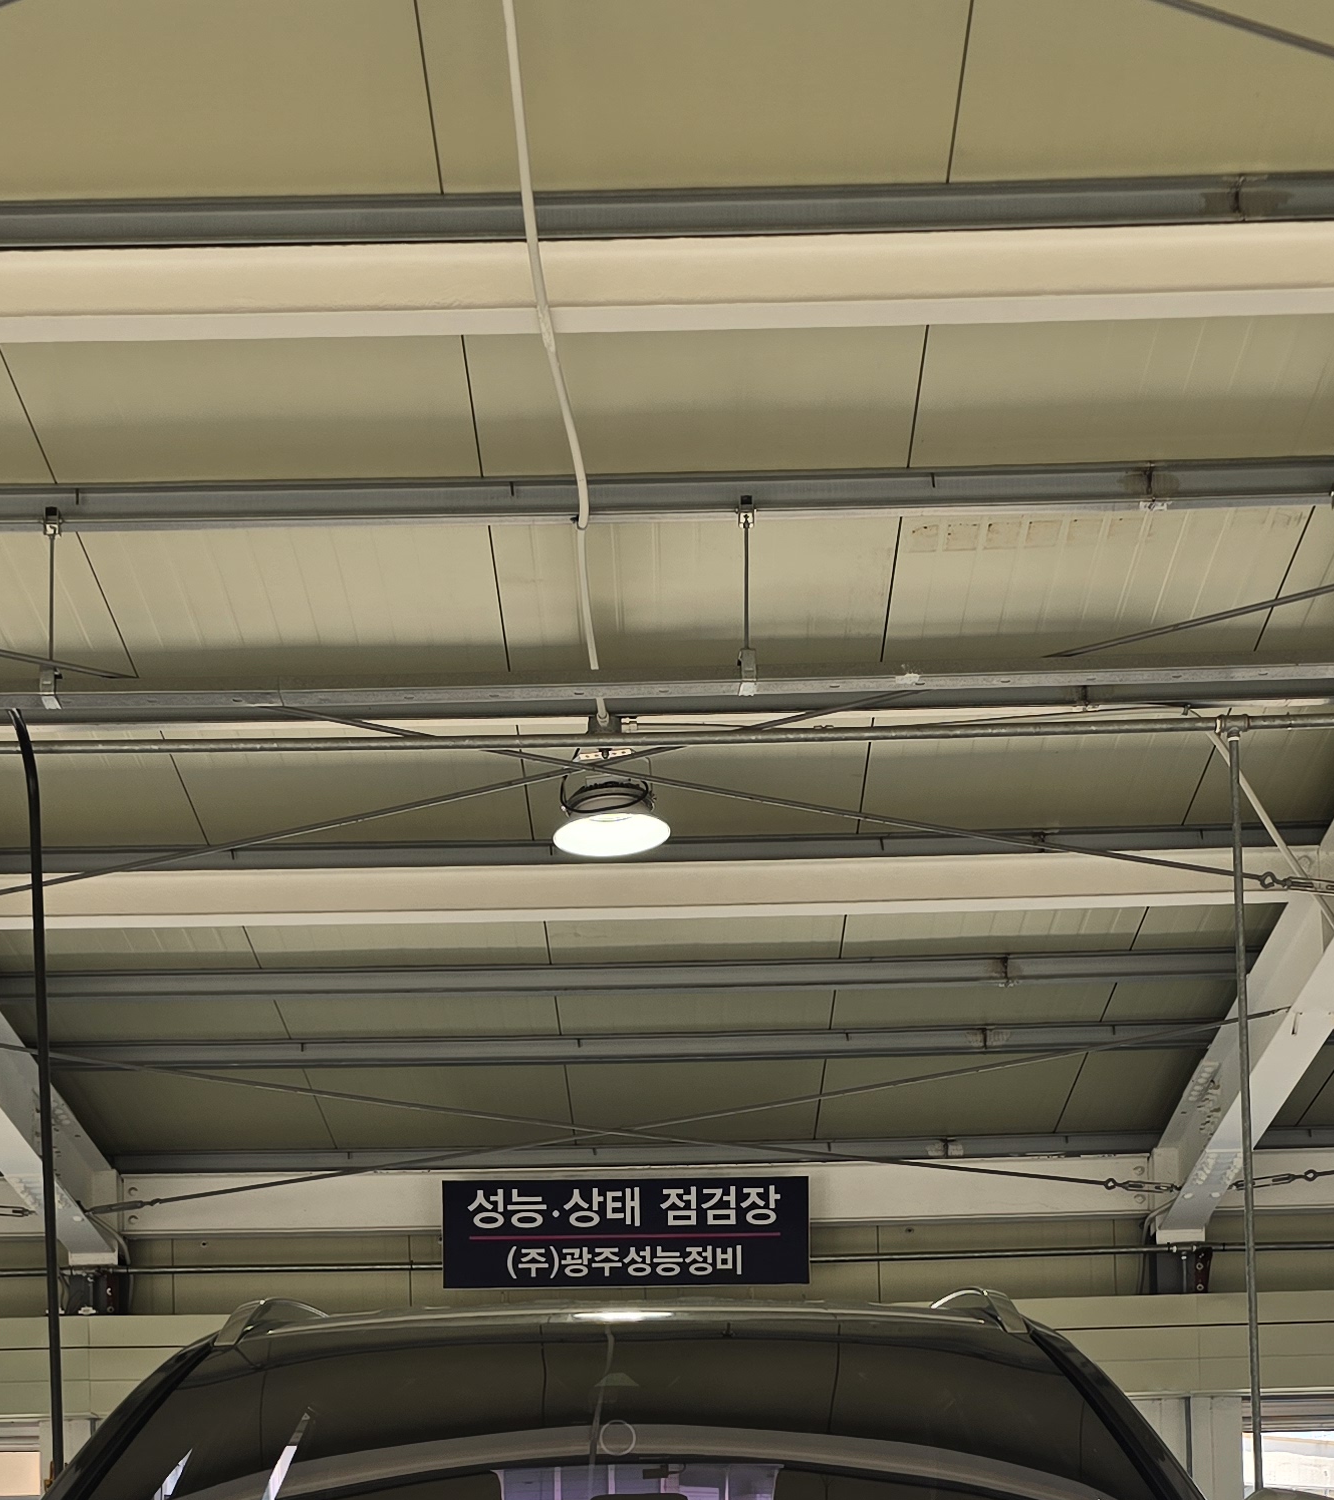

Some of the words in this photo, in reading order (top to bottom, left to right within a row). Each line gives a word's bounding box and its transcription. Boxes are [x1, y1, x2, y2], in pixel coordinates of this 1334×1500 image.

[467, 1187, 641, 1229] 성능·상태
[660, 1185, 781, 1227] 점검장
[506, 1245, 743, 1279] (주)광주성능정비
